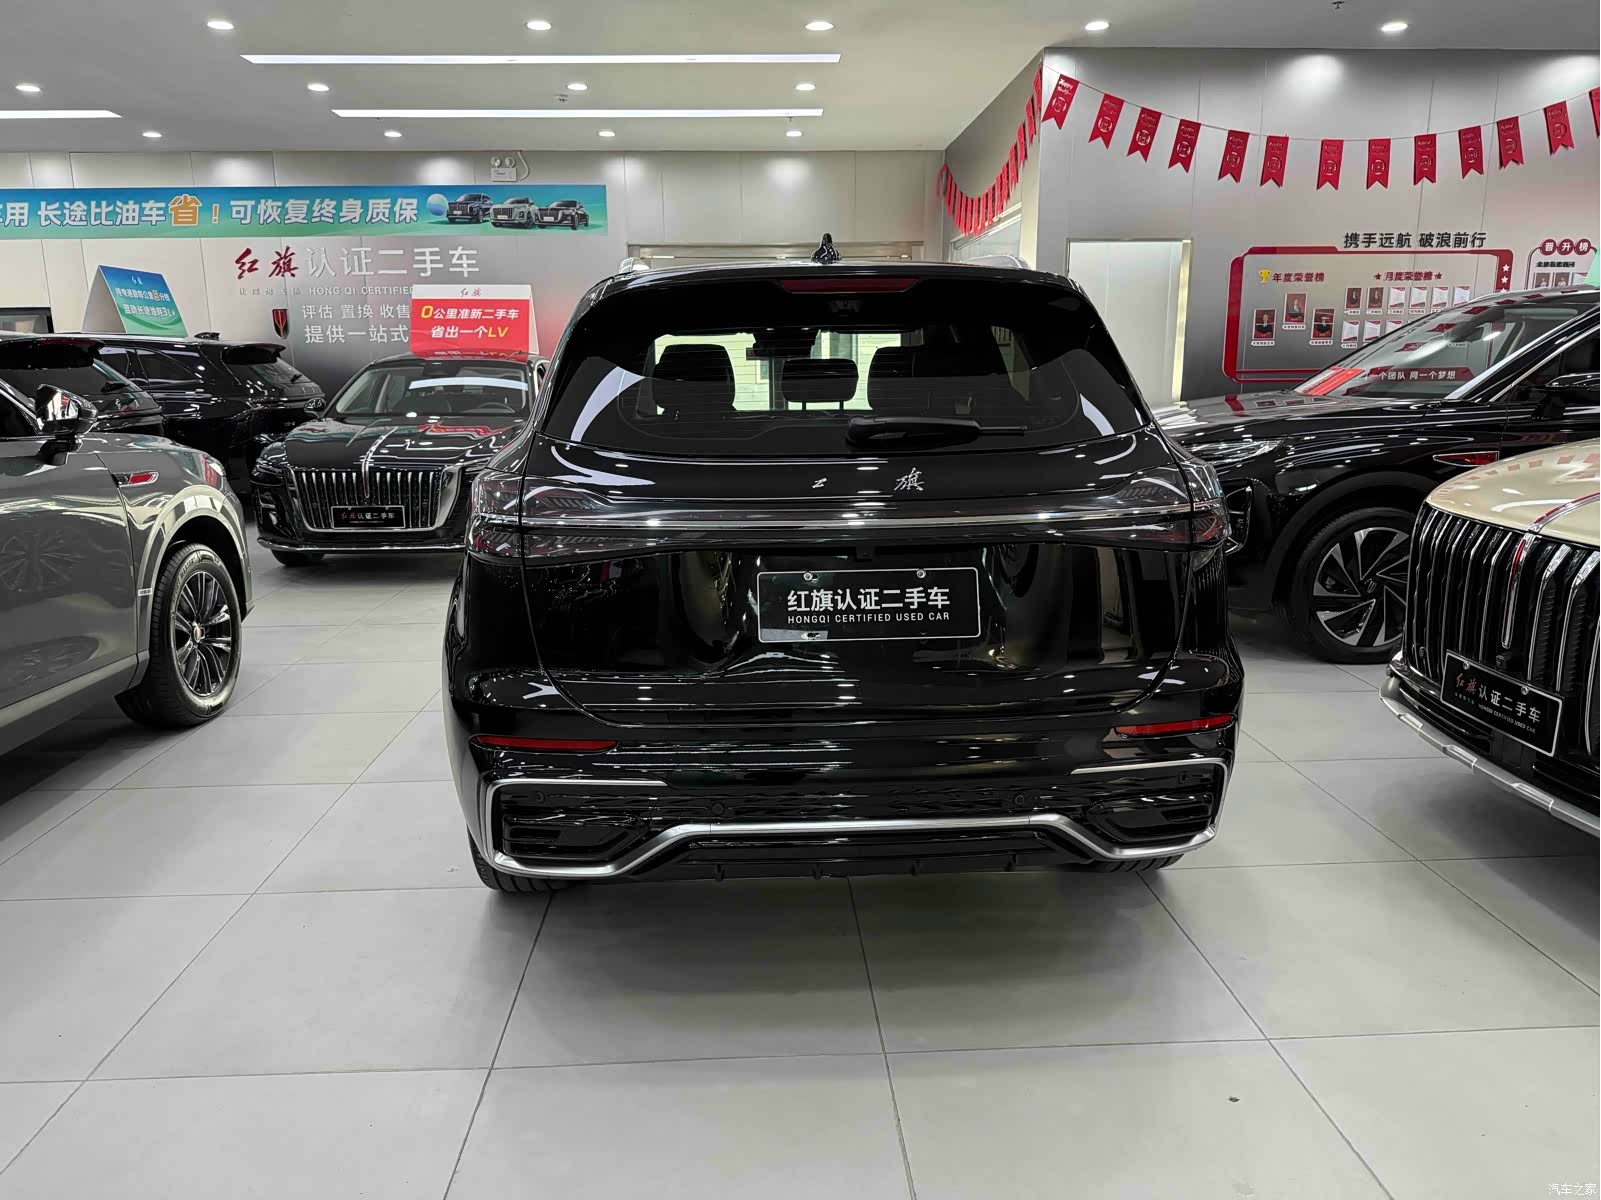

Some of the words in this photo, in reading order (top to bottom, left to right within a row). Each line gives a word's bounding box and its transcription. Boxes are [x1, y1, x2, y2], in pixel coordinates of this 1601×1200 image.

[0, 200, 29, 227] 用
[1344, 232, 1412, 248] 携手远航
[1418, 231, 1486, 248] 破浪前行
[1545, 241, 1589, 252] 晋升榜
[235, 246, 480, 279] 红旗认证二手车
[1272, 271, 1325, 283] 年度荣誉榜
[309, 286, 341, 296] HONG
[344, 286, 358, 296] QI
[301, 304, 334, 320] 评估
[341, 304, 374, 319] 置换
[380, 303, 411, 319] 收售
[421, 305, 519, 319] 0公里准新二手车
[304, 324, 410, 344] 提供一站式
[430, 325, 509, 339] 省出一个LV
[787, 587, 950, 612] 红旗认证二手车
[787, 615, 830, 624] HONGQI
[835, 613, 891, 623] CERTIFIED
[896, 612, 924, 621] USED
[928, 611, 950, 621] CAR
[1455, 672, 1541, 723] 红旗认证二手车
